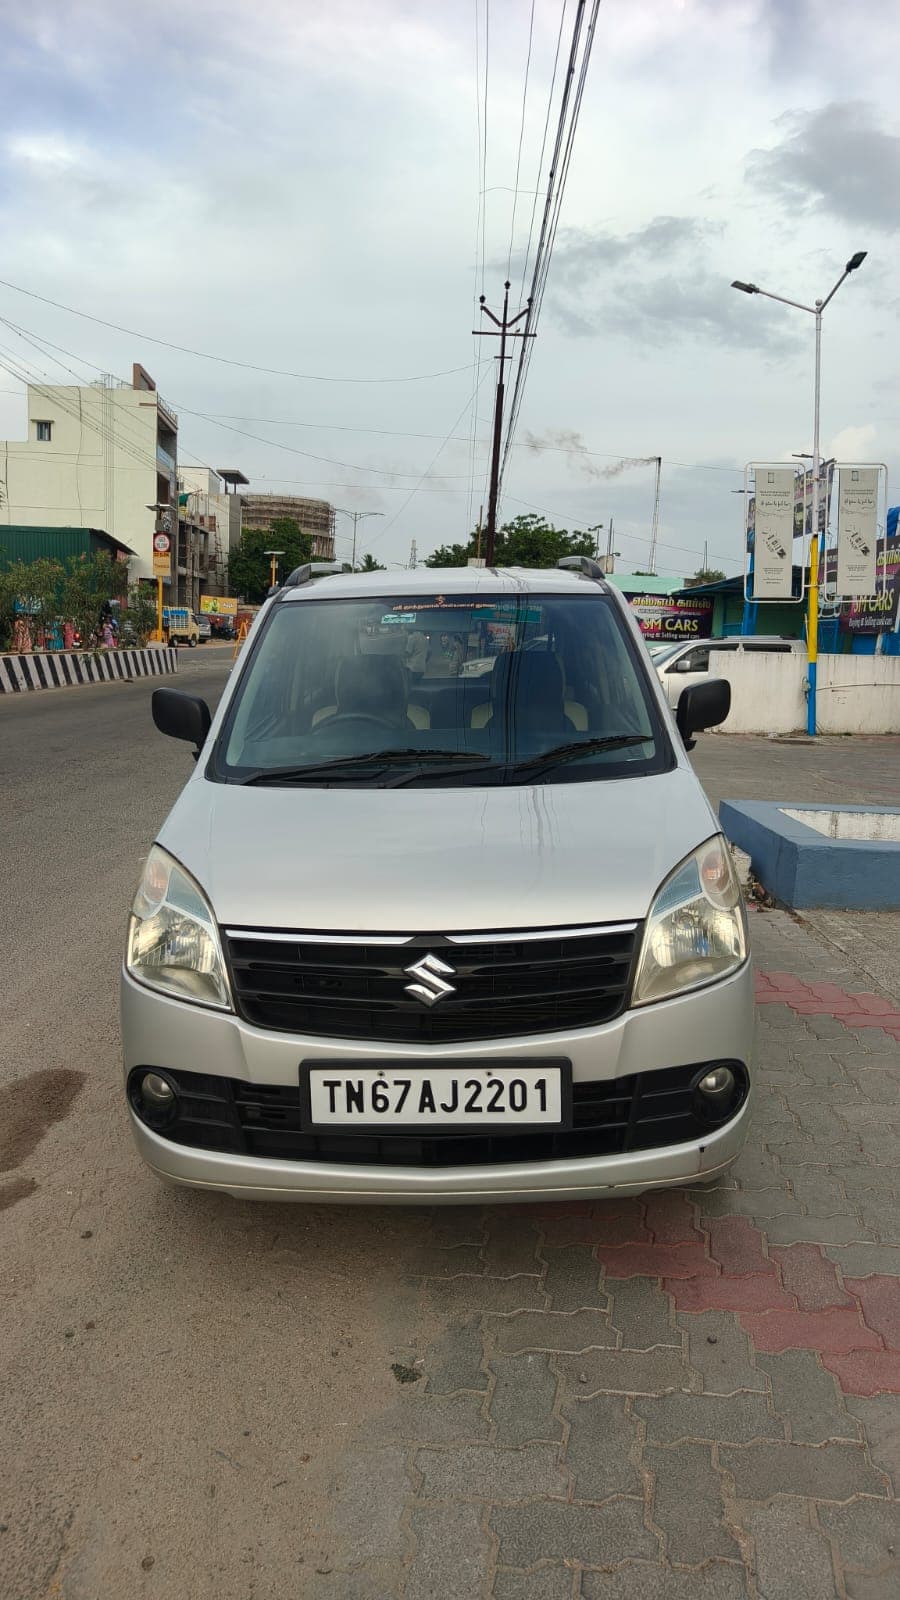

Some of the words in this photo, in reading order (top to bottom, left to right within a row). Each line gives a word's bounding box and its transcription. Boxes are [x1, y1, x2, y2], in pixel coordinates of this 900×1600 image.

[643, 617, 662, 630] SM
[665, 618, 699, 631] CARS
[323, 1078, 548, 1113] TN67AJ2201
